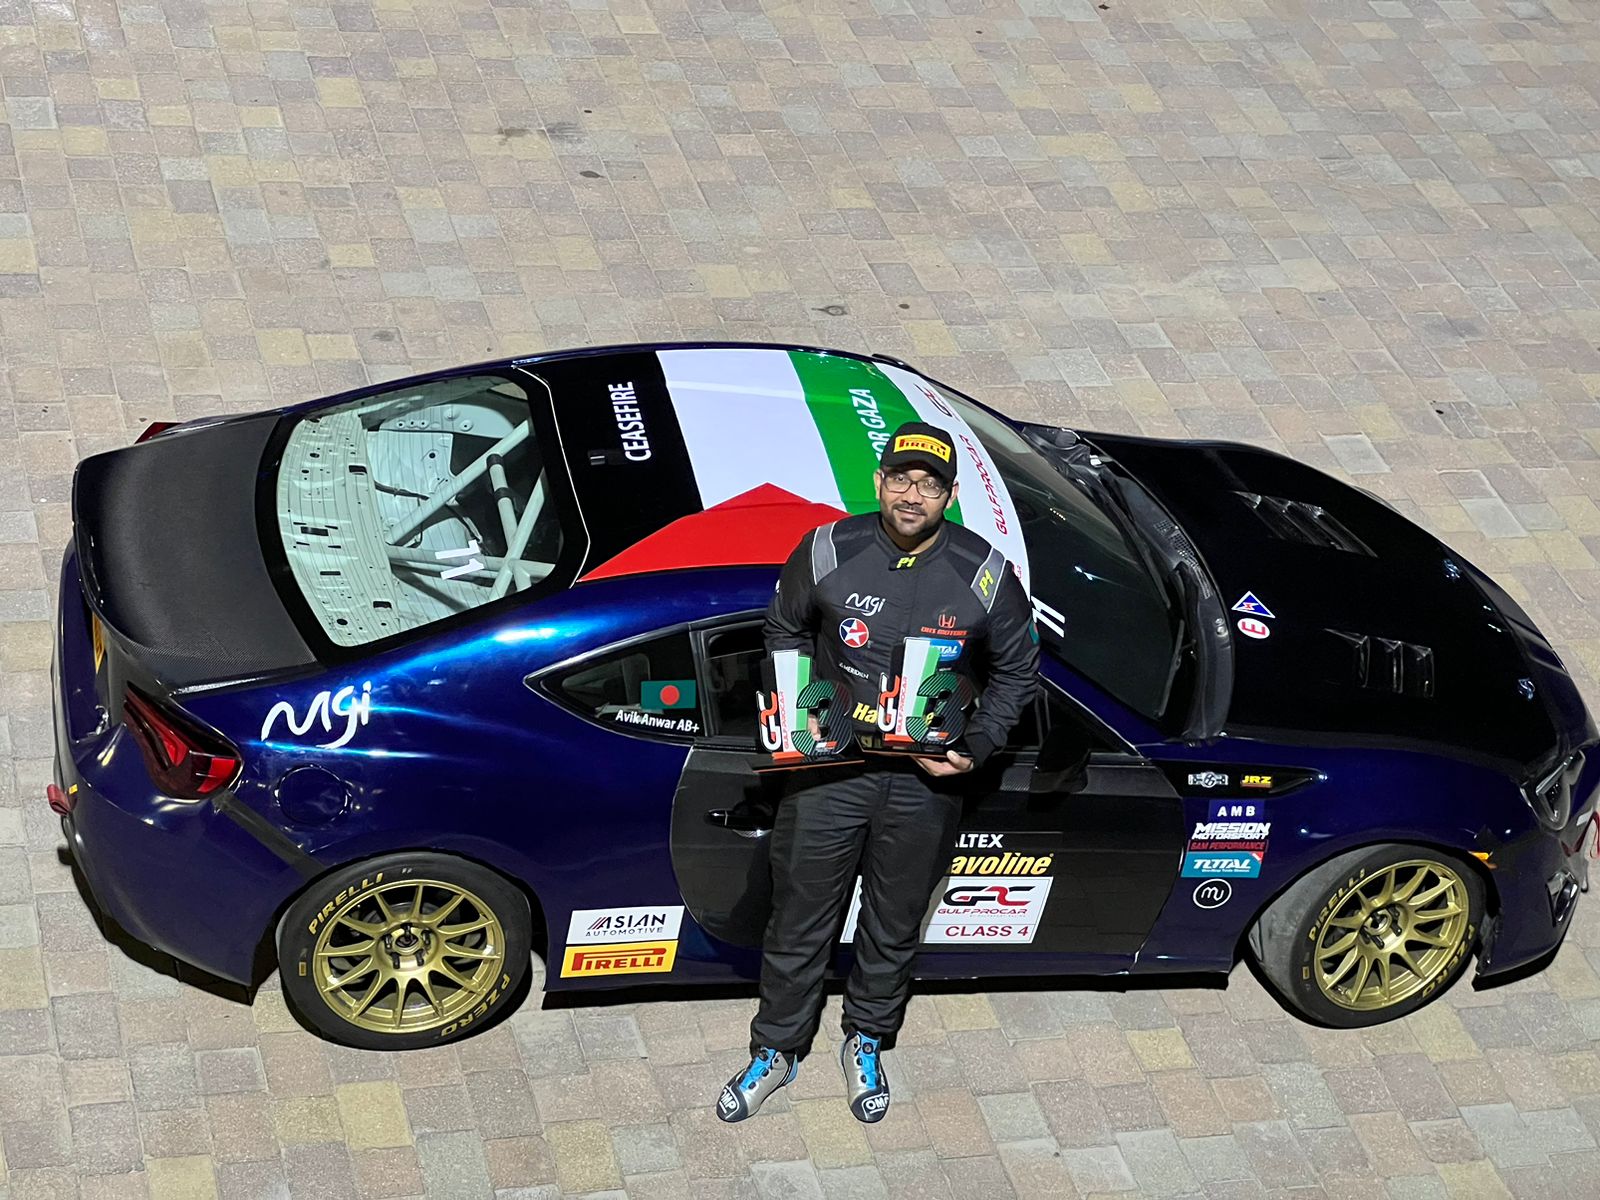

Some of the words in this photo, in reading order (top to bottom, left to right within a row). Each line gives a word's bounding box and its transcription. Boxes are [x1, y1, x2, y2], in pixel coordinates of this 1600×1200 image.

[848, 388, 886, 429] GAZA
[607, 381, 652, 461] CEASEFIRE
[899, 438, 947, 457] PIRELLI
[896, 556, 916, 568] P1
[978, 569, 994, 597] P1
[937, 645, 958, 654] TAL
[615, 709, 640, 724] Avik
[640, 713, 676, 730] Anwar
[676, 718, 700, 733] AB+
[1242, 775, 1272, 784] JRZ
[1191, 832, 1269, 840] MOTORSPORT
[1195, 822, 1271, 834] MISSION
[955, 833, 1004, 848] LTEX
[1209, 842, 1266, 850] PERFORMANCE
[951, 852, 1052, 875] avoline
[1193, 858, 1252, 870] TOTAL
[308, 872, 384, 935] PIRELLI
[1308, 868, 1365, 941] PIRELLI
[590, 913, 667, 930] ASIAN
[585, 927, 663, 937] AUTOMOTIVE
[945, 925, 1012, 937] CLASS
[1017, 925, 1029, 937] 4
[571, 947, 667, 972] PIRELLI
[501, 973, 511, 990] P
[441, 992, 502, 1037] ZERO
